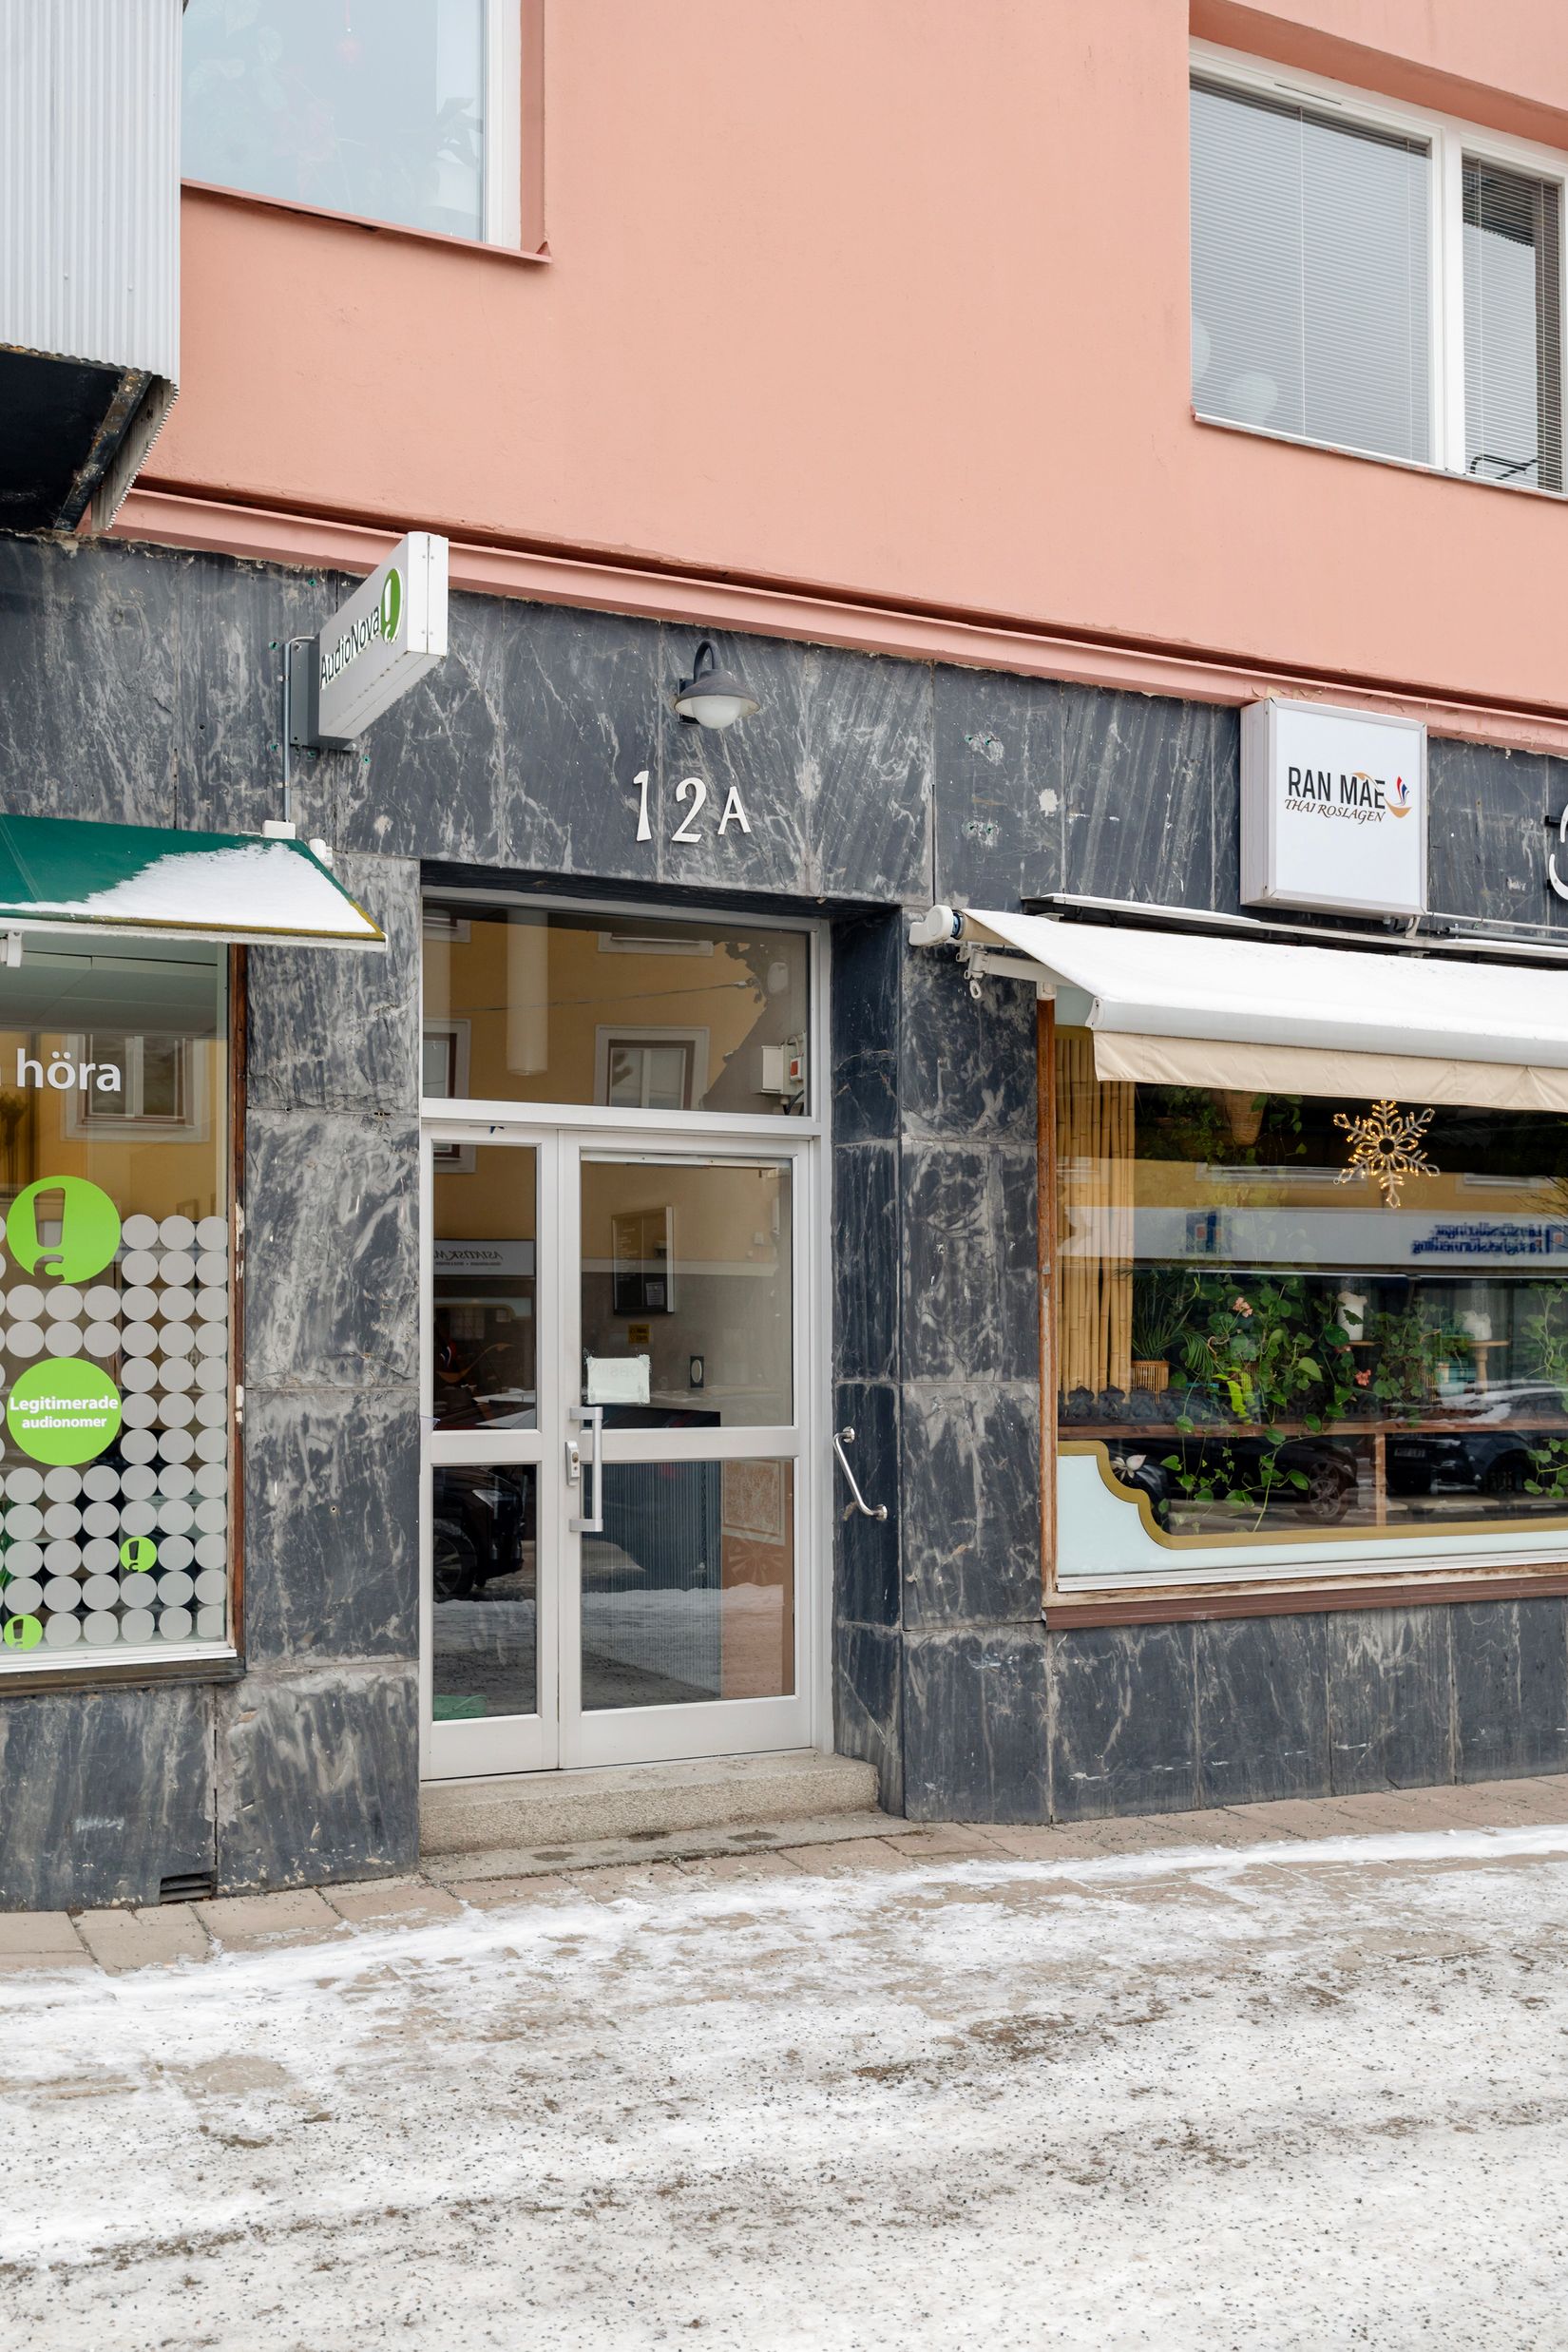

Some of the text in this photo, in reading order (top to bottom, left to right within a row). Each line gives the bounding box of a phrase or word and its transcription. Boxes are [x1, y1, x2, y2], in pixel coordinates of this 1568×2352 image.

[319, 605, 380, 690] AudioNova
[1288, 766, 1386, 810] RAN MAE
[1284, 798, 1386, 825] THAI ROSLAGEN
[16, 1047, 122, 1092] höra
[10, 1394, 119, 1414] Legitimerade
[22, 1415, 107, 1428] audionomer
